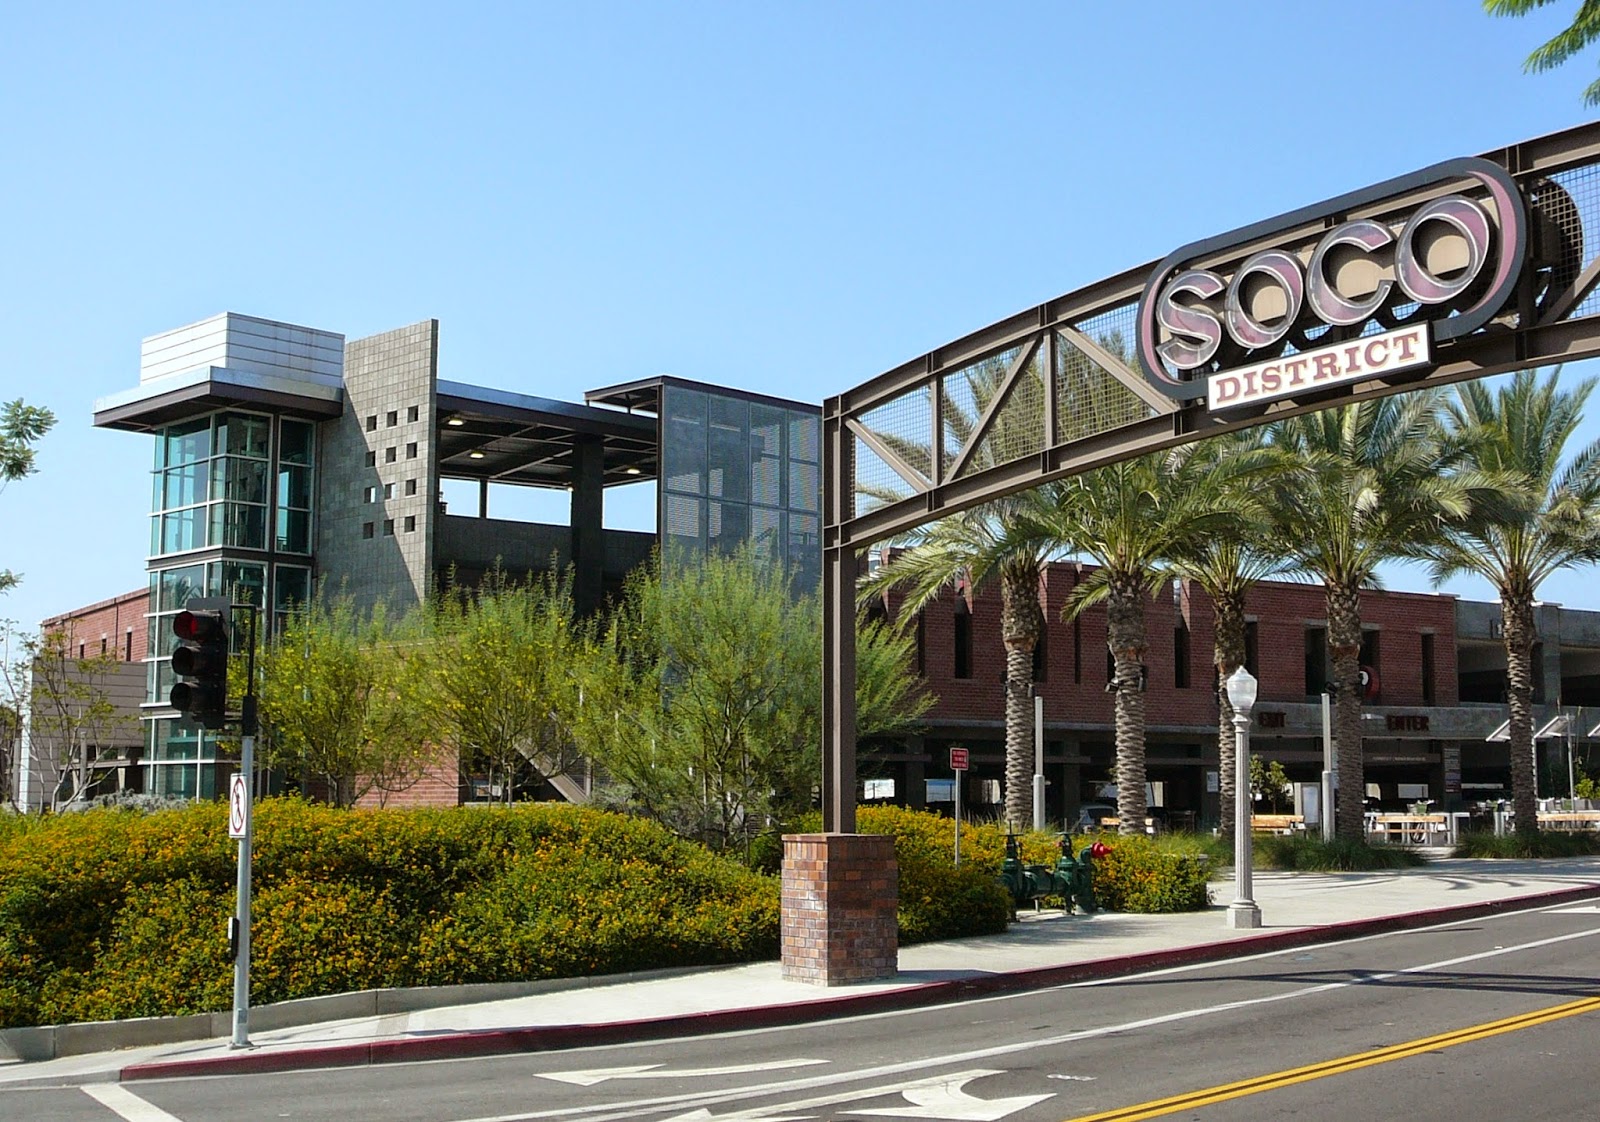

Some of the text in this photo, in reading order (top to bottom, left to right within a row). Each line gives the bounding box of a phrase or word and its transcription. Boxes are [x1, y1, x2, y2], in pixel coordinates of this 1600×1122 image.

[1156, 195, 1491, 370] SOCO
[1216, 332, 1420, 404] DISTRICT
[1387, 714, 1429, 731] ENTER
